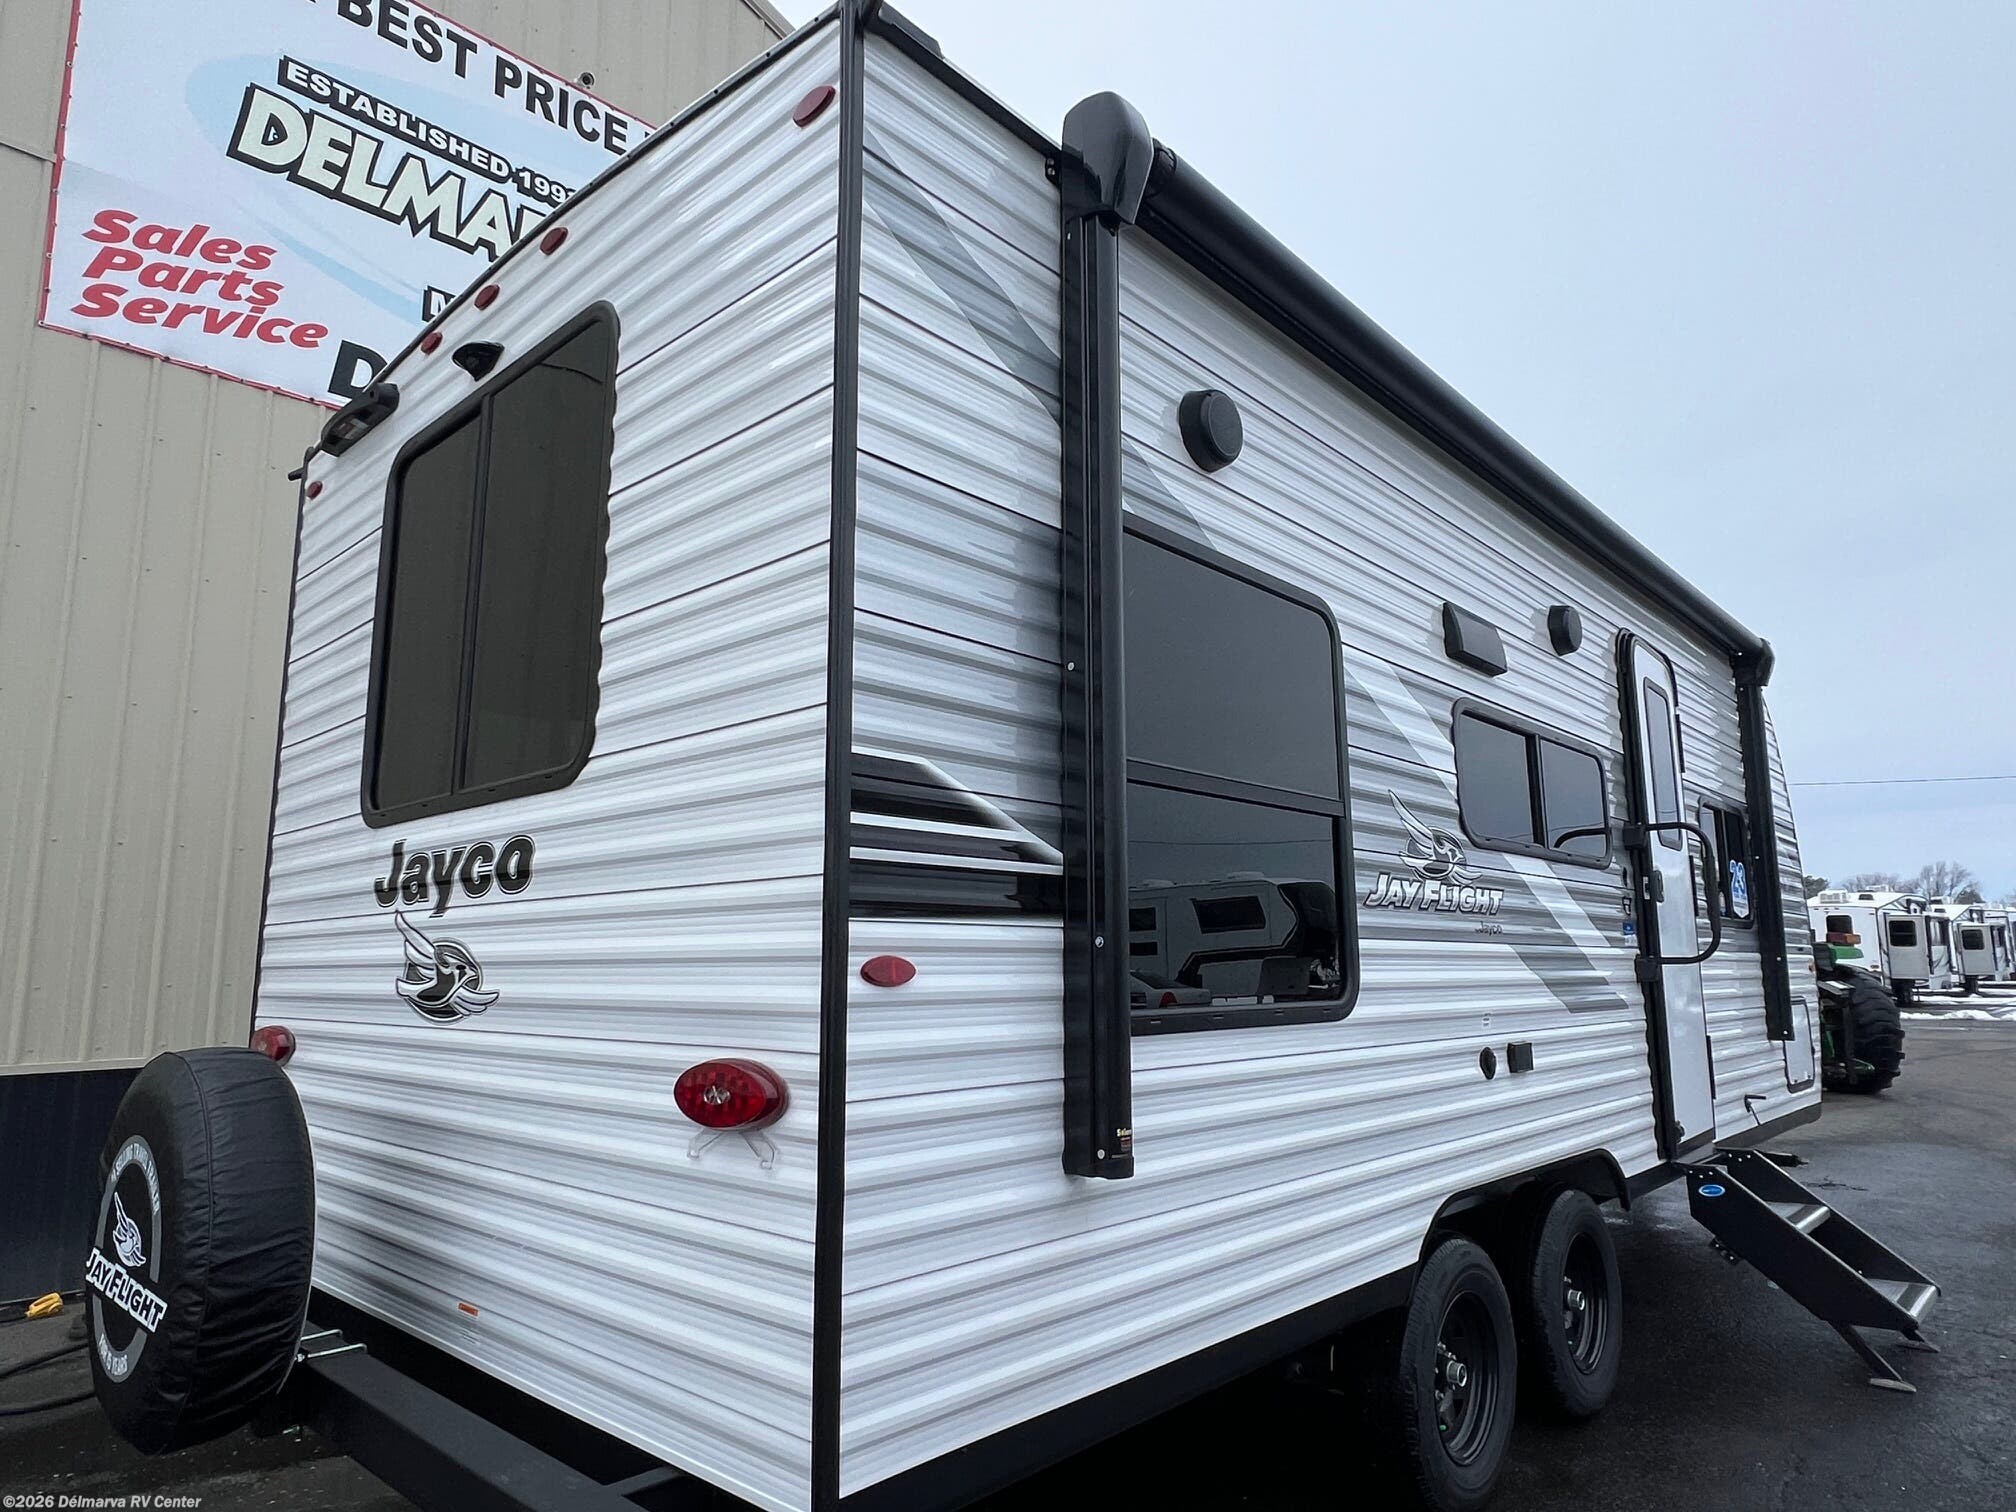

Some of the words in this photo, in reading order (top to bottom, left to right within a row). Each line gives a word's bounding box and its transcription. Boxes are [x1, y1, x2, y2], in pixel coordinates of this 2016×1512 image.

[338, 0, 478, 79] BEST
[494, 55, 630, 156] PRICE
[284, 59, 511, 180] ESTABLISHED
[517, 168, 577, 206] 199
[81, 209, 278, 271] Sales
[82, 246, 285, 306] Parts
[71, 282, 329, 348] Service
[374, 834, 535, 918] Jayco
